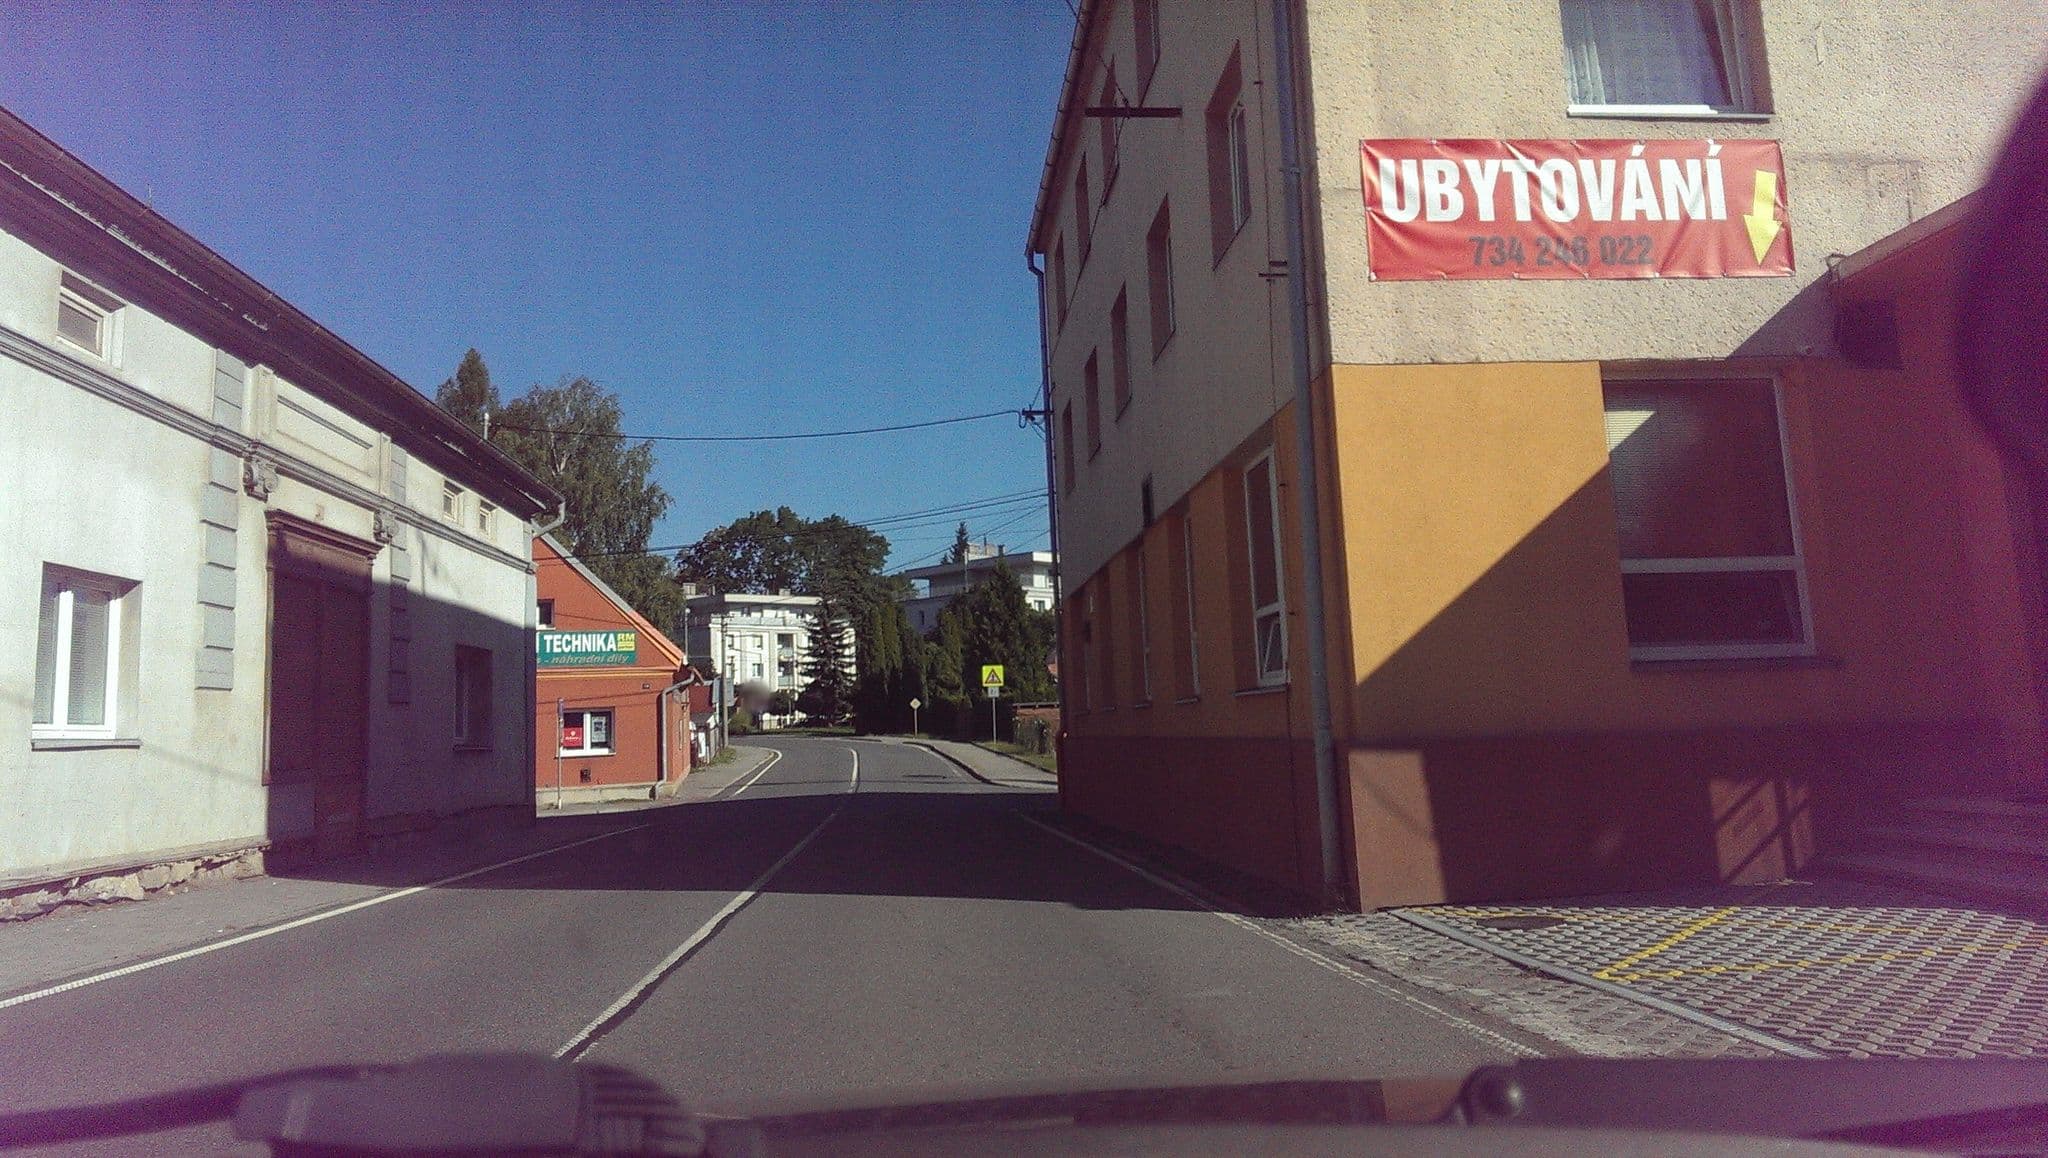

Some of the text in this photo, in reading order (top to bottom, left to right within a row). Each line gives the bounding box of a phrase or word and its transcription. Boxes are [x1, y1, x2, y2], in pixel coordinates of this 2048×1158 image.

[1378, 144, 1728, 223] UBYTOVÁNÍ
[1470, 235, 1655, 267] 734 246 022
[543, 632, 617, 653] TECHNIKA
